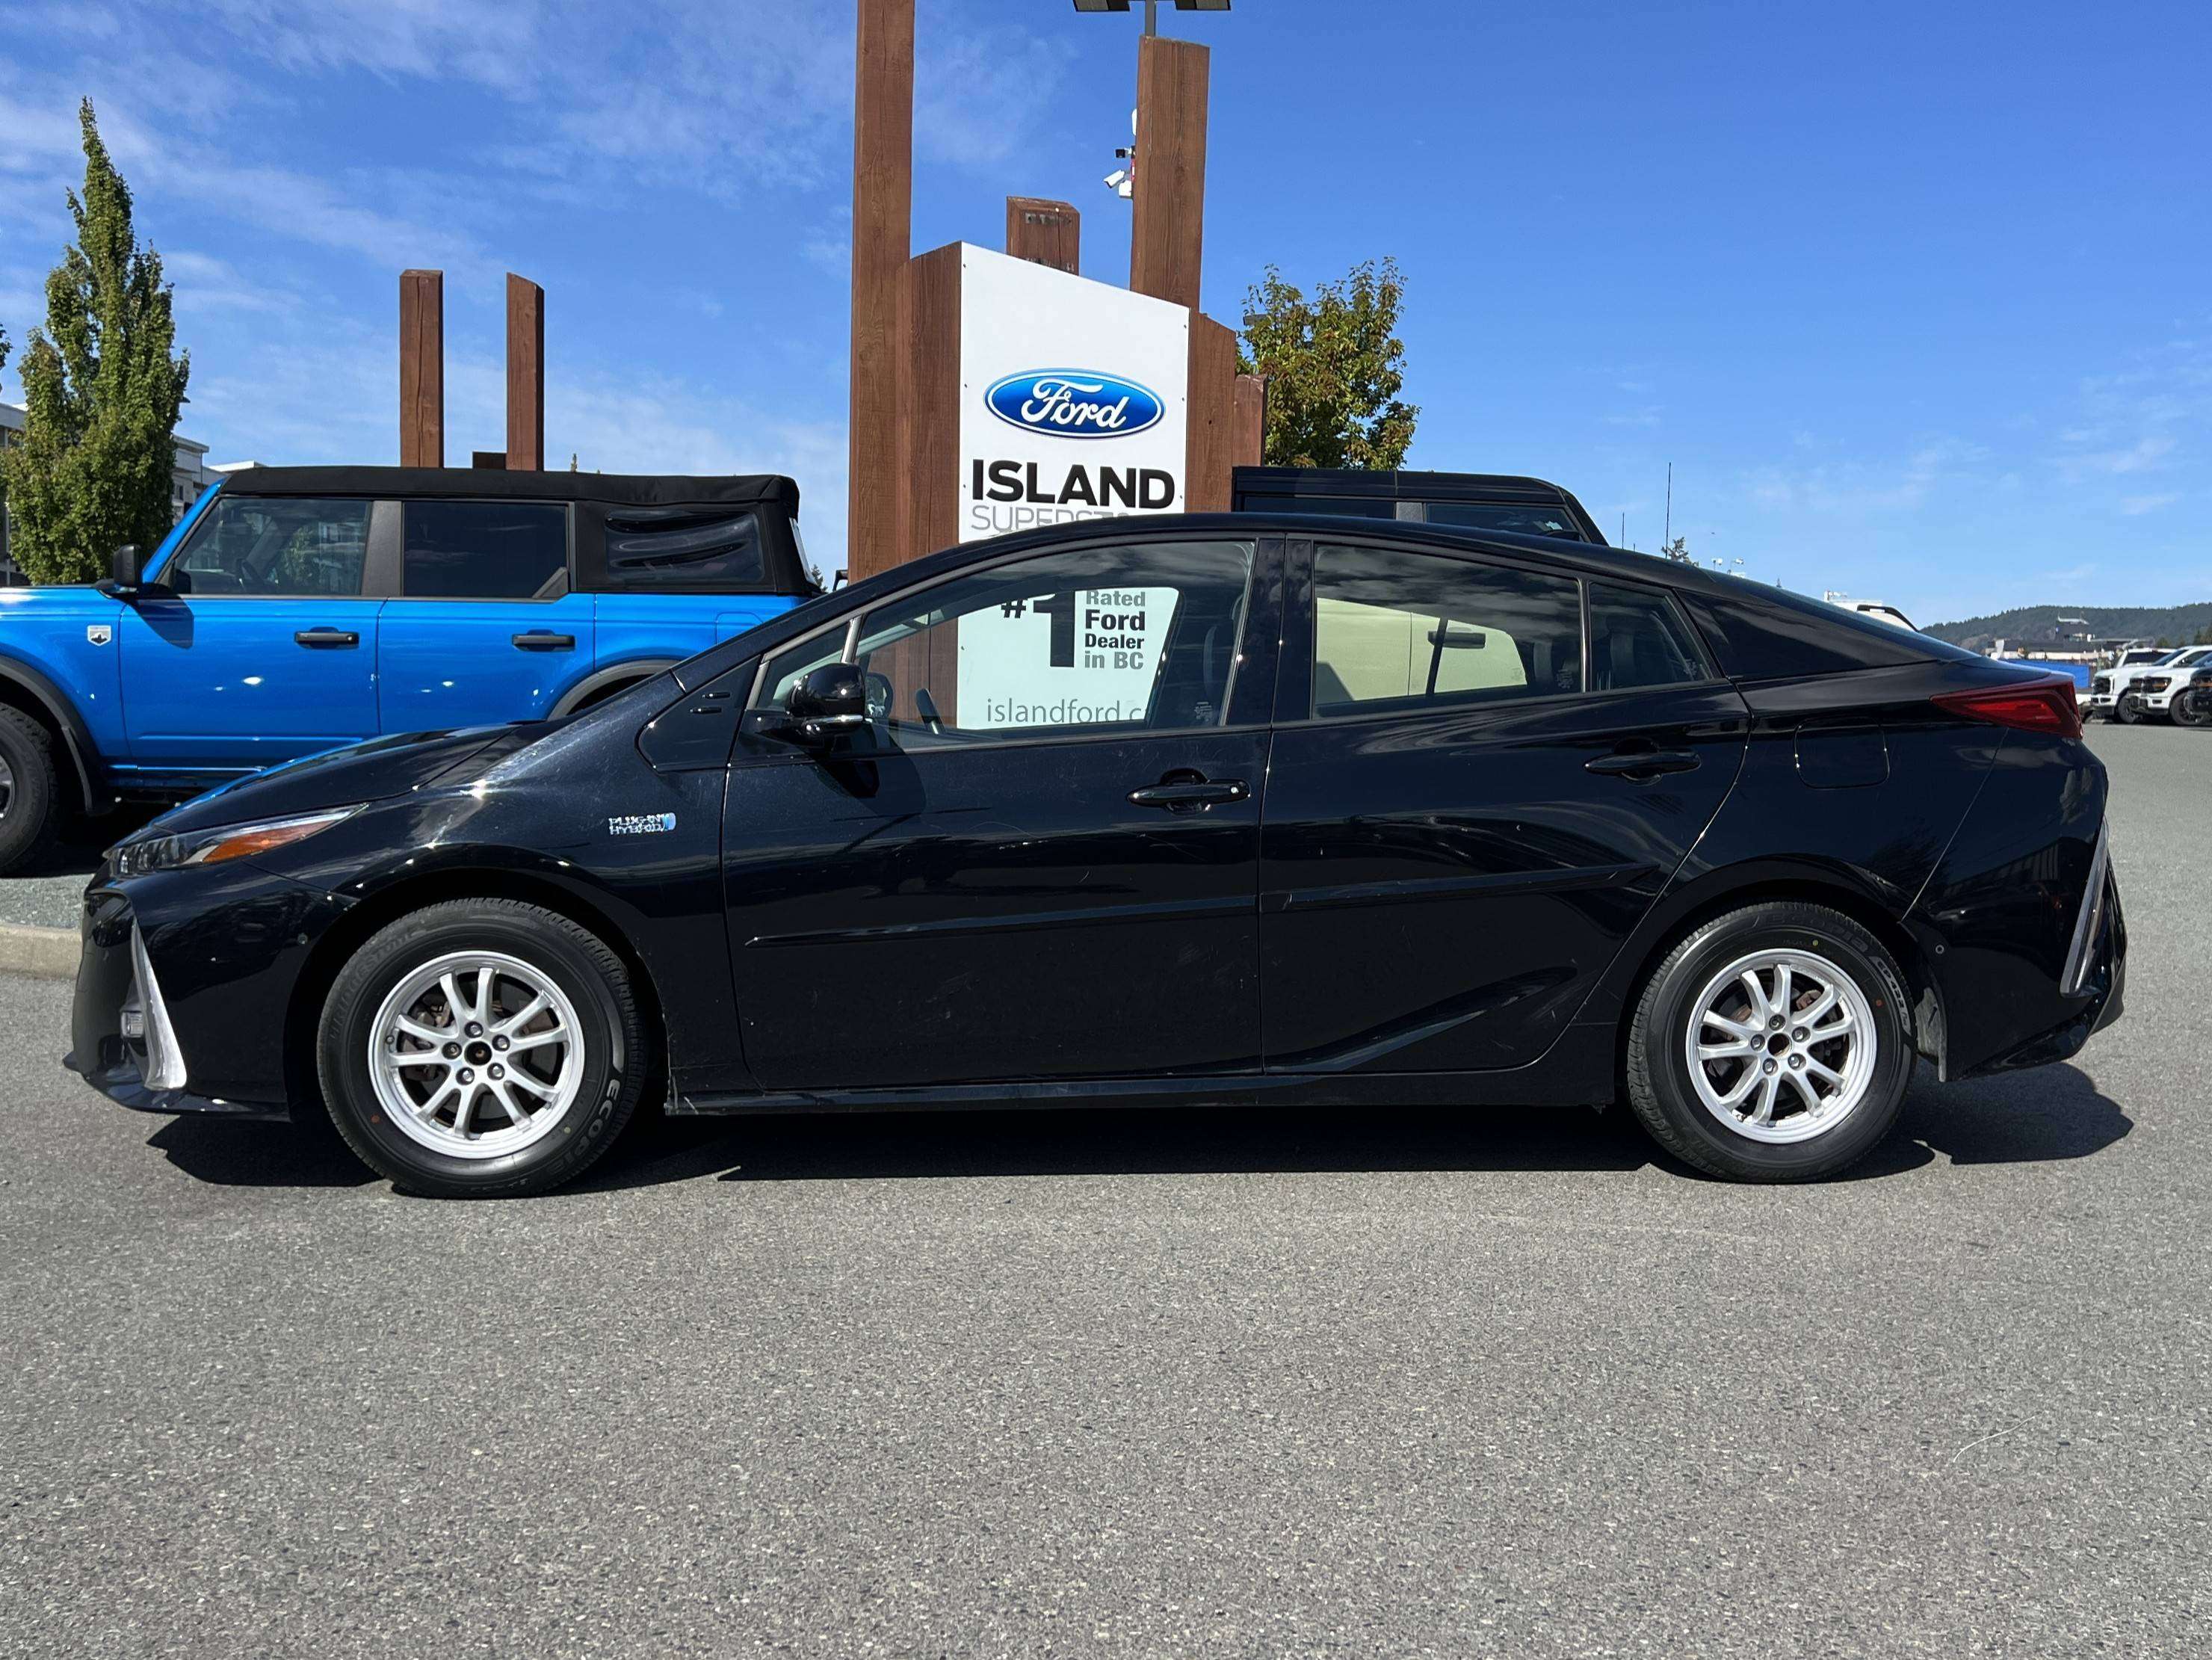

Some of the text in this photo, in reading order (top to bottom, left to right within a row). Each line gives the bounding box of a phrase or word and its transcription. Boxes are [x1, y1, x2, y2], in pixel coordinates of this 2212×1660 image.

[1021, 378, 1130, 429] Ford
[972, 459, 1175, 509] ISLAND
[1085, 590, 1146, 607] Rated
[1001, 590, 1075, 668] #1
[1085, 608, 1146, 632] Ford
[1084, 633, 1145, 650] Dealer
[1084, 650, 1144, 670] in BC
[986, 698, 1142, 723] islandfordc
